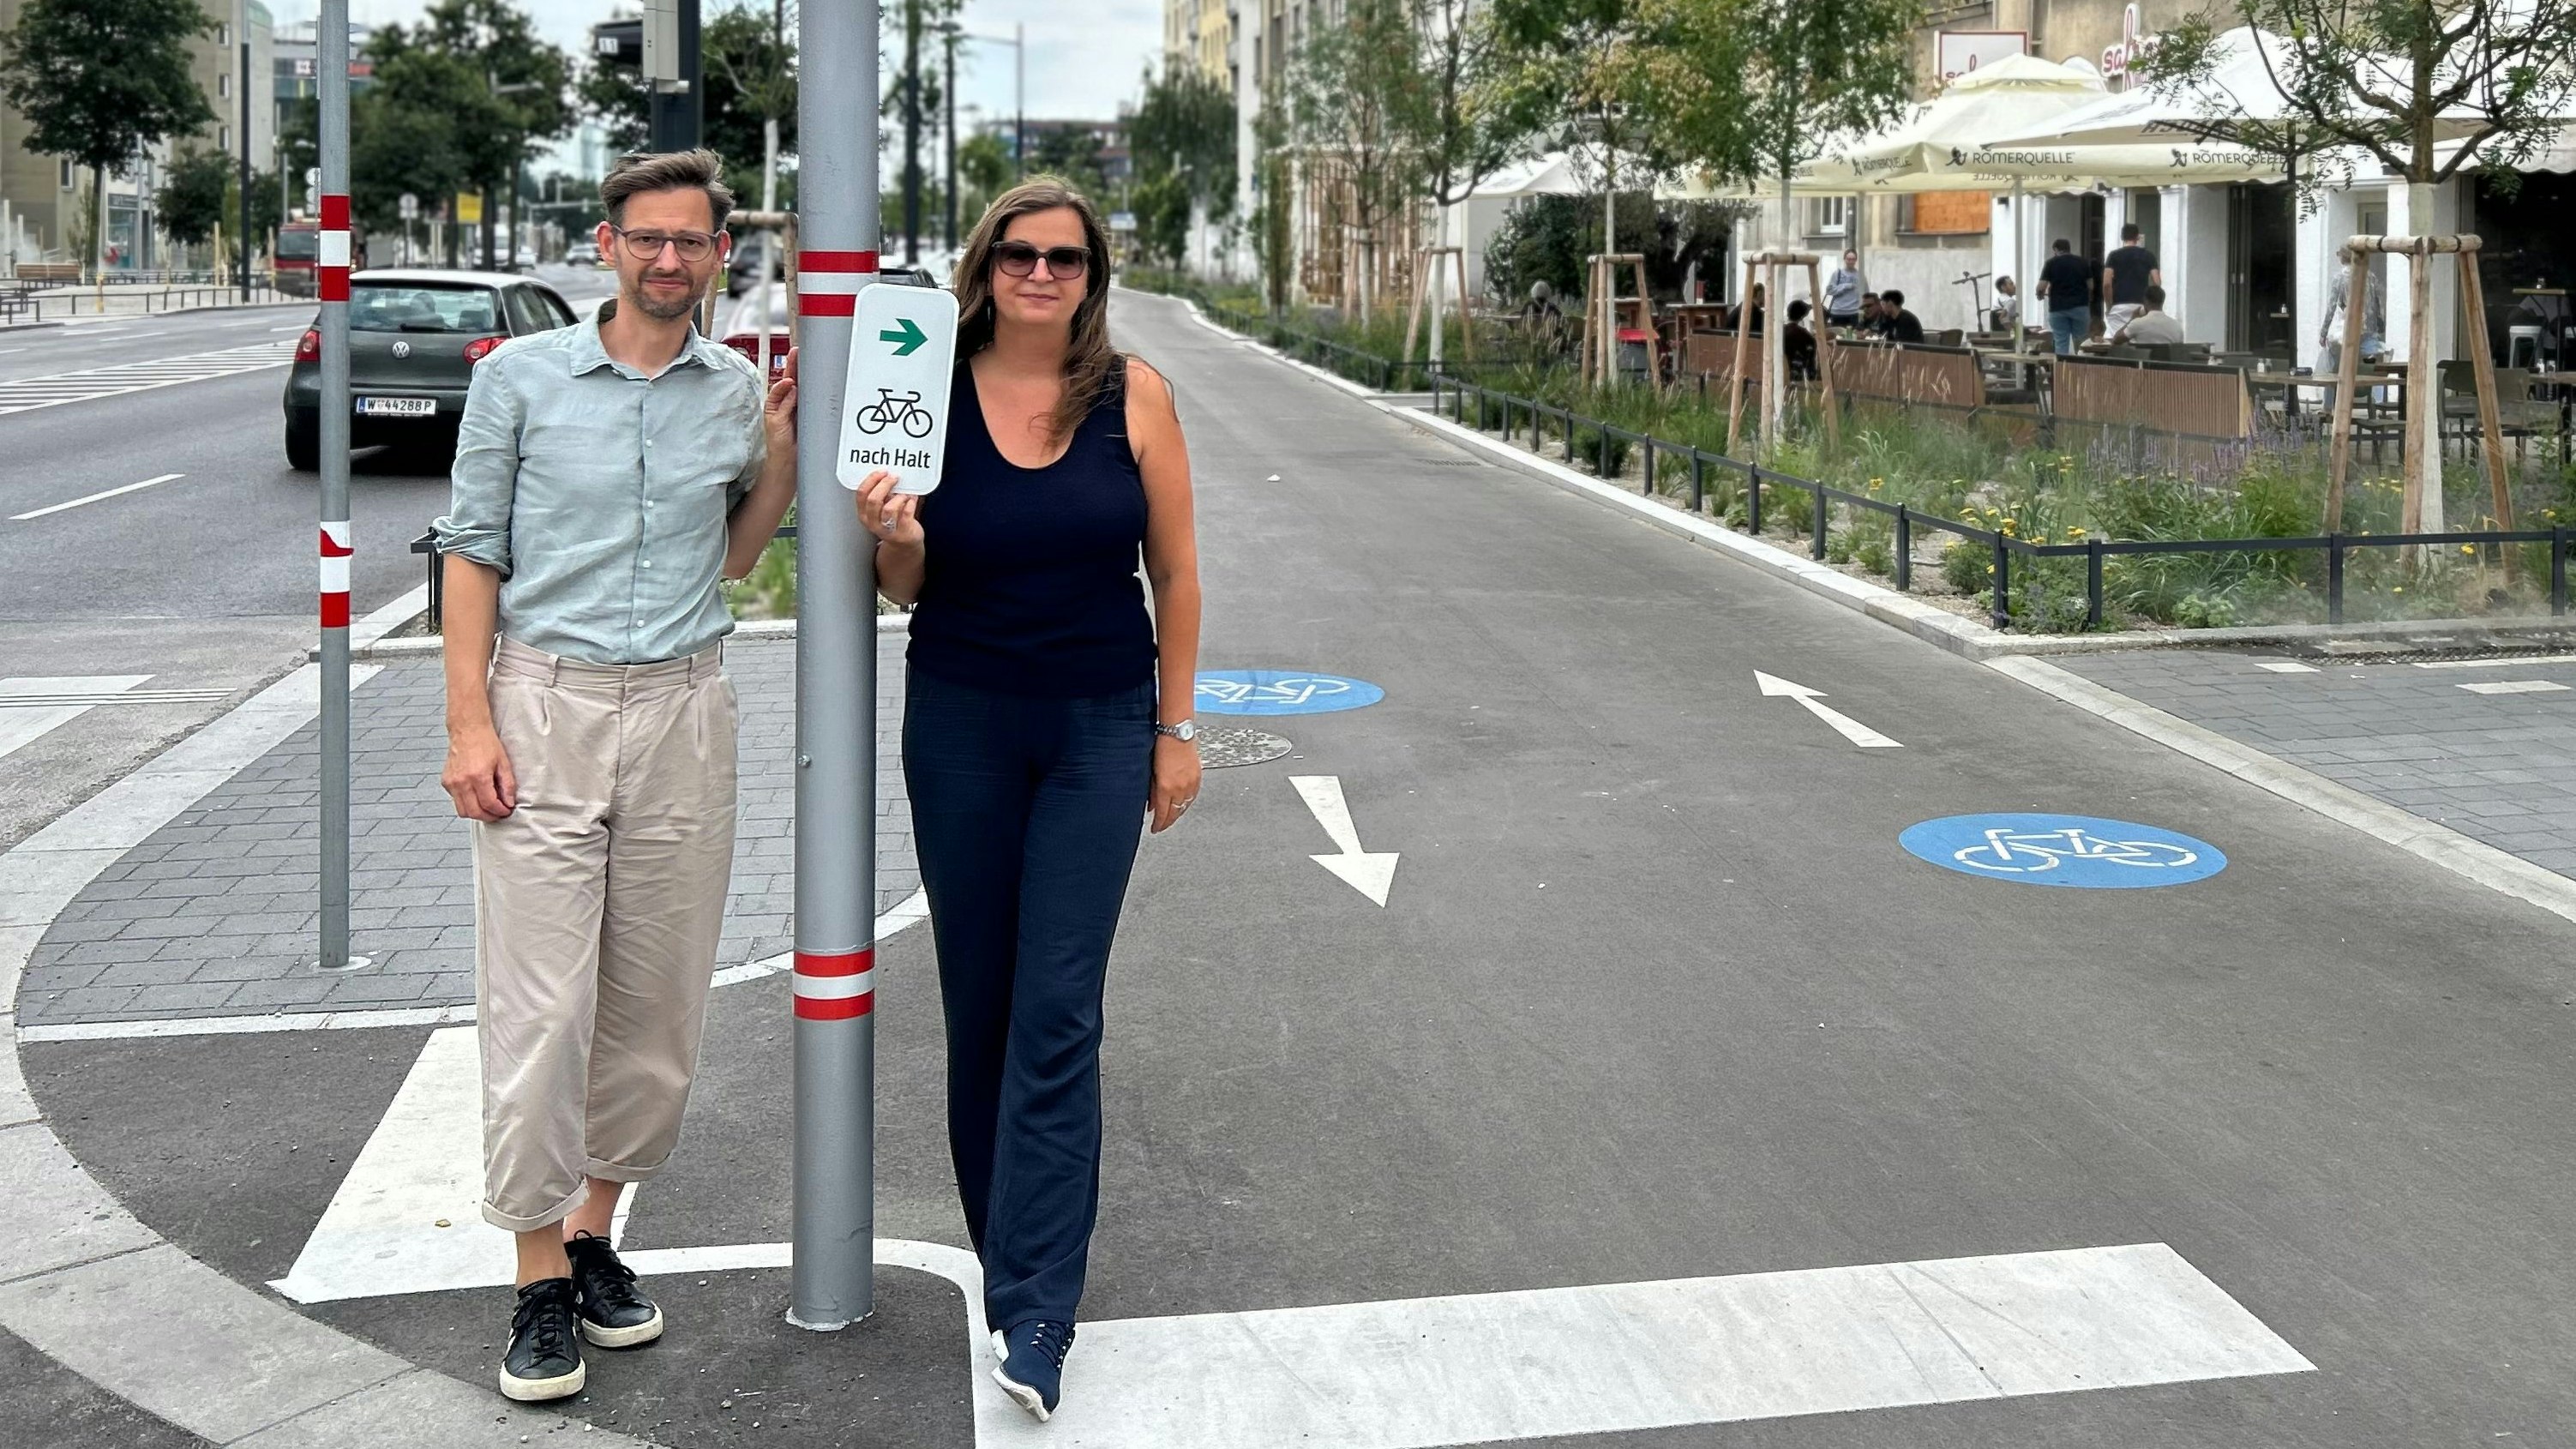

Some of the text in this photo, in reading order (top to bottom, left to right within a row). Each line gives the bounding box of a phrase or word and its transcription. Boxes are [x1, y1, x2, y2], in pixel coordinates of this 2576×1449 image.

[368, 399, 376, 410] W
[850, 447, 931, 468] nach Halt
